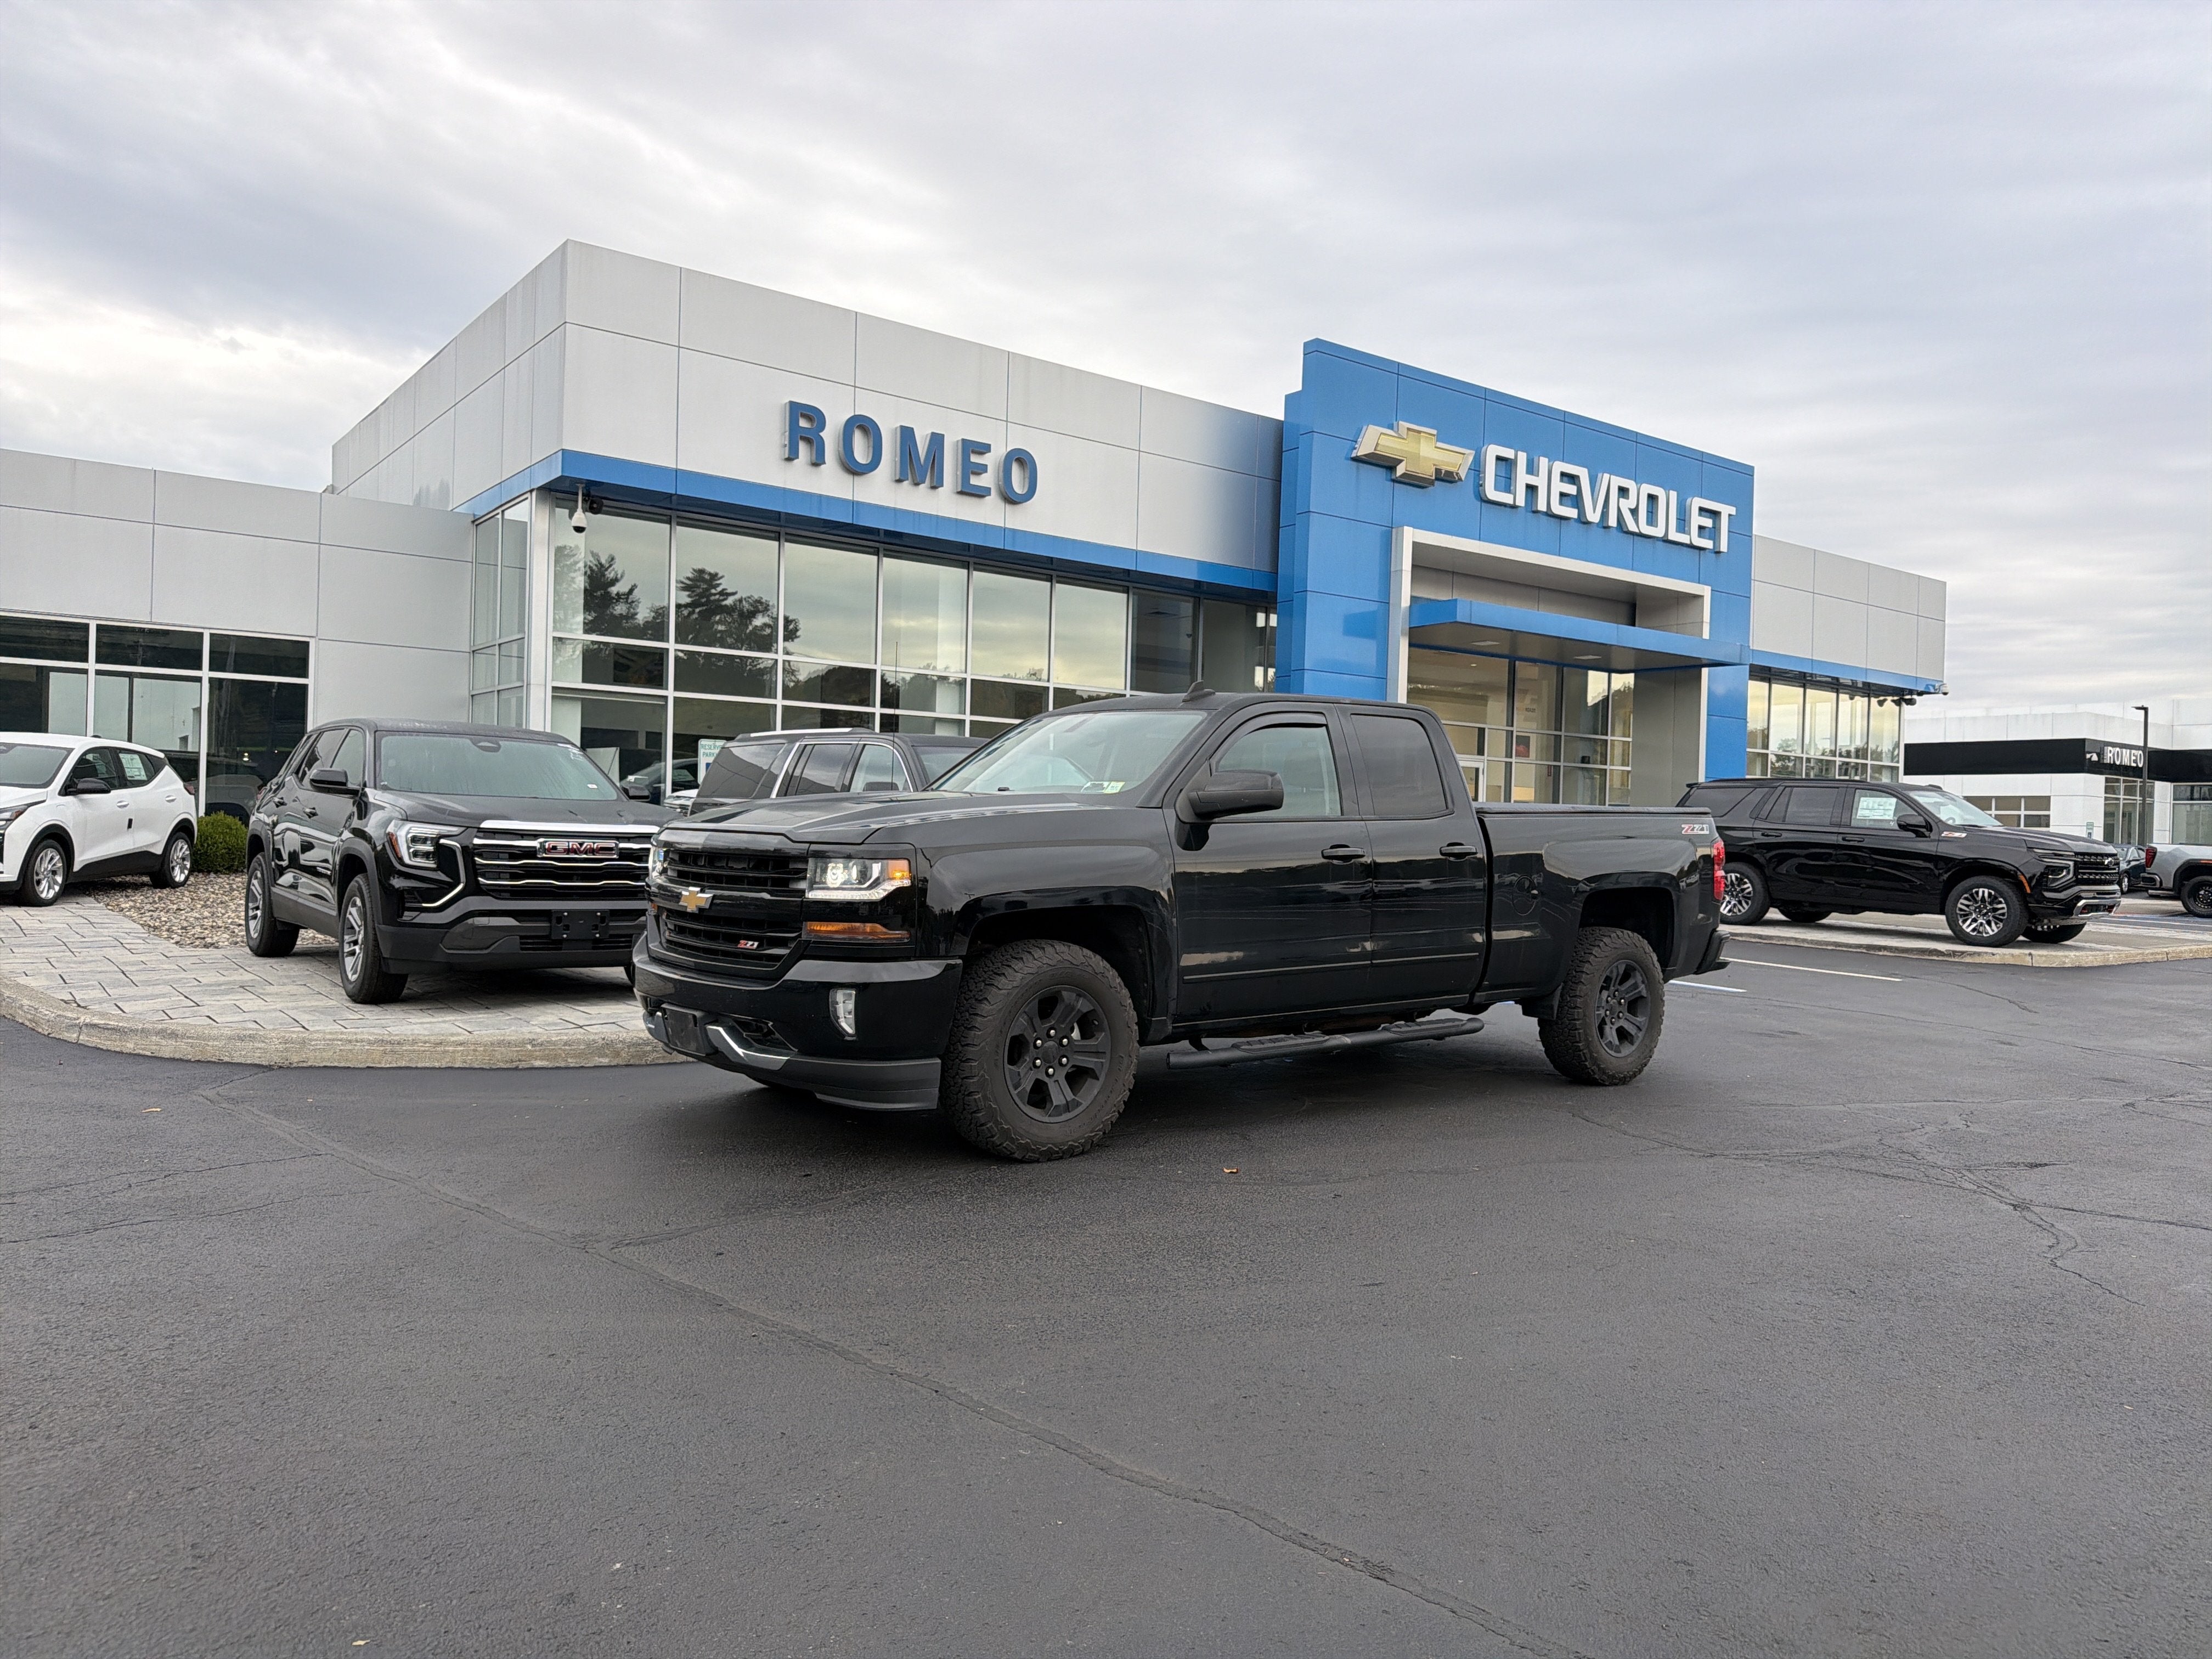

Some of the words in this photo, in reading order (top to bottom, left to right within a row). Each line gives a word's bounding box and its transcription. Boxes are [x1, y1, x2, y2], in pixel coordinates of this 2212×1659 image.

[785, 400, 1038, 504] ROMEO
[1481, 444, 1736, 553] CHEVROLET
[2107, 746, 2144, 768] ROMEO
[1681, 824, 1709, 834] Z71
[545, 841, 616, 855] GMC
